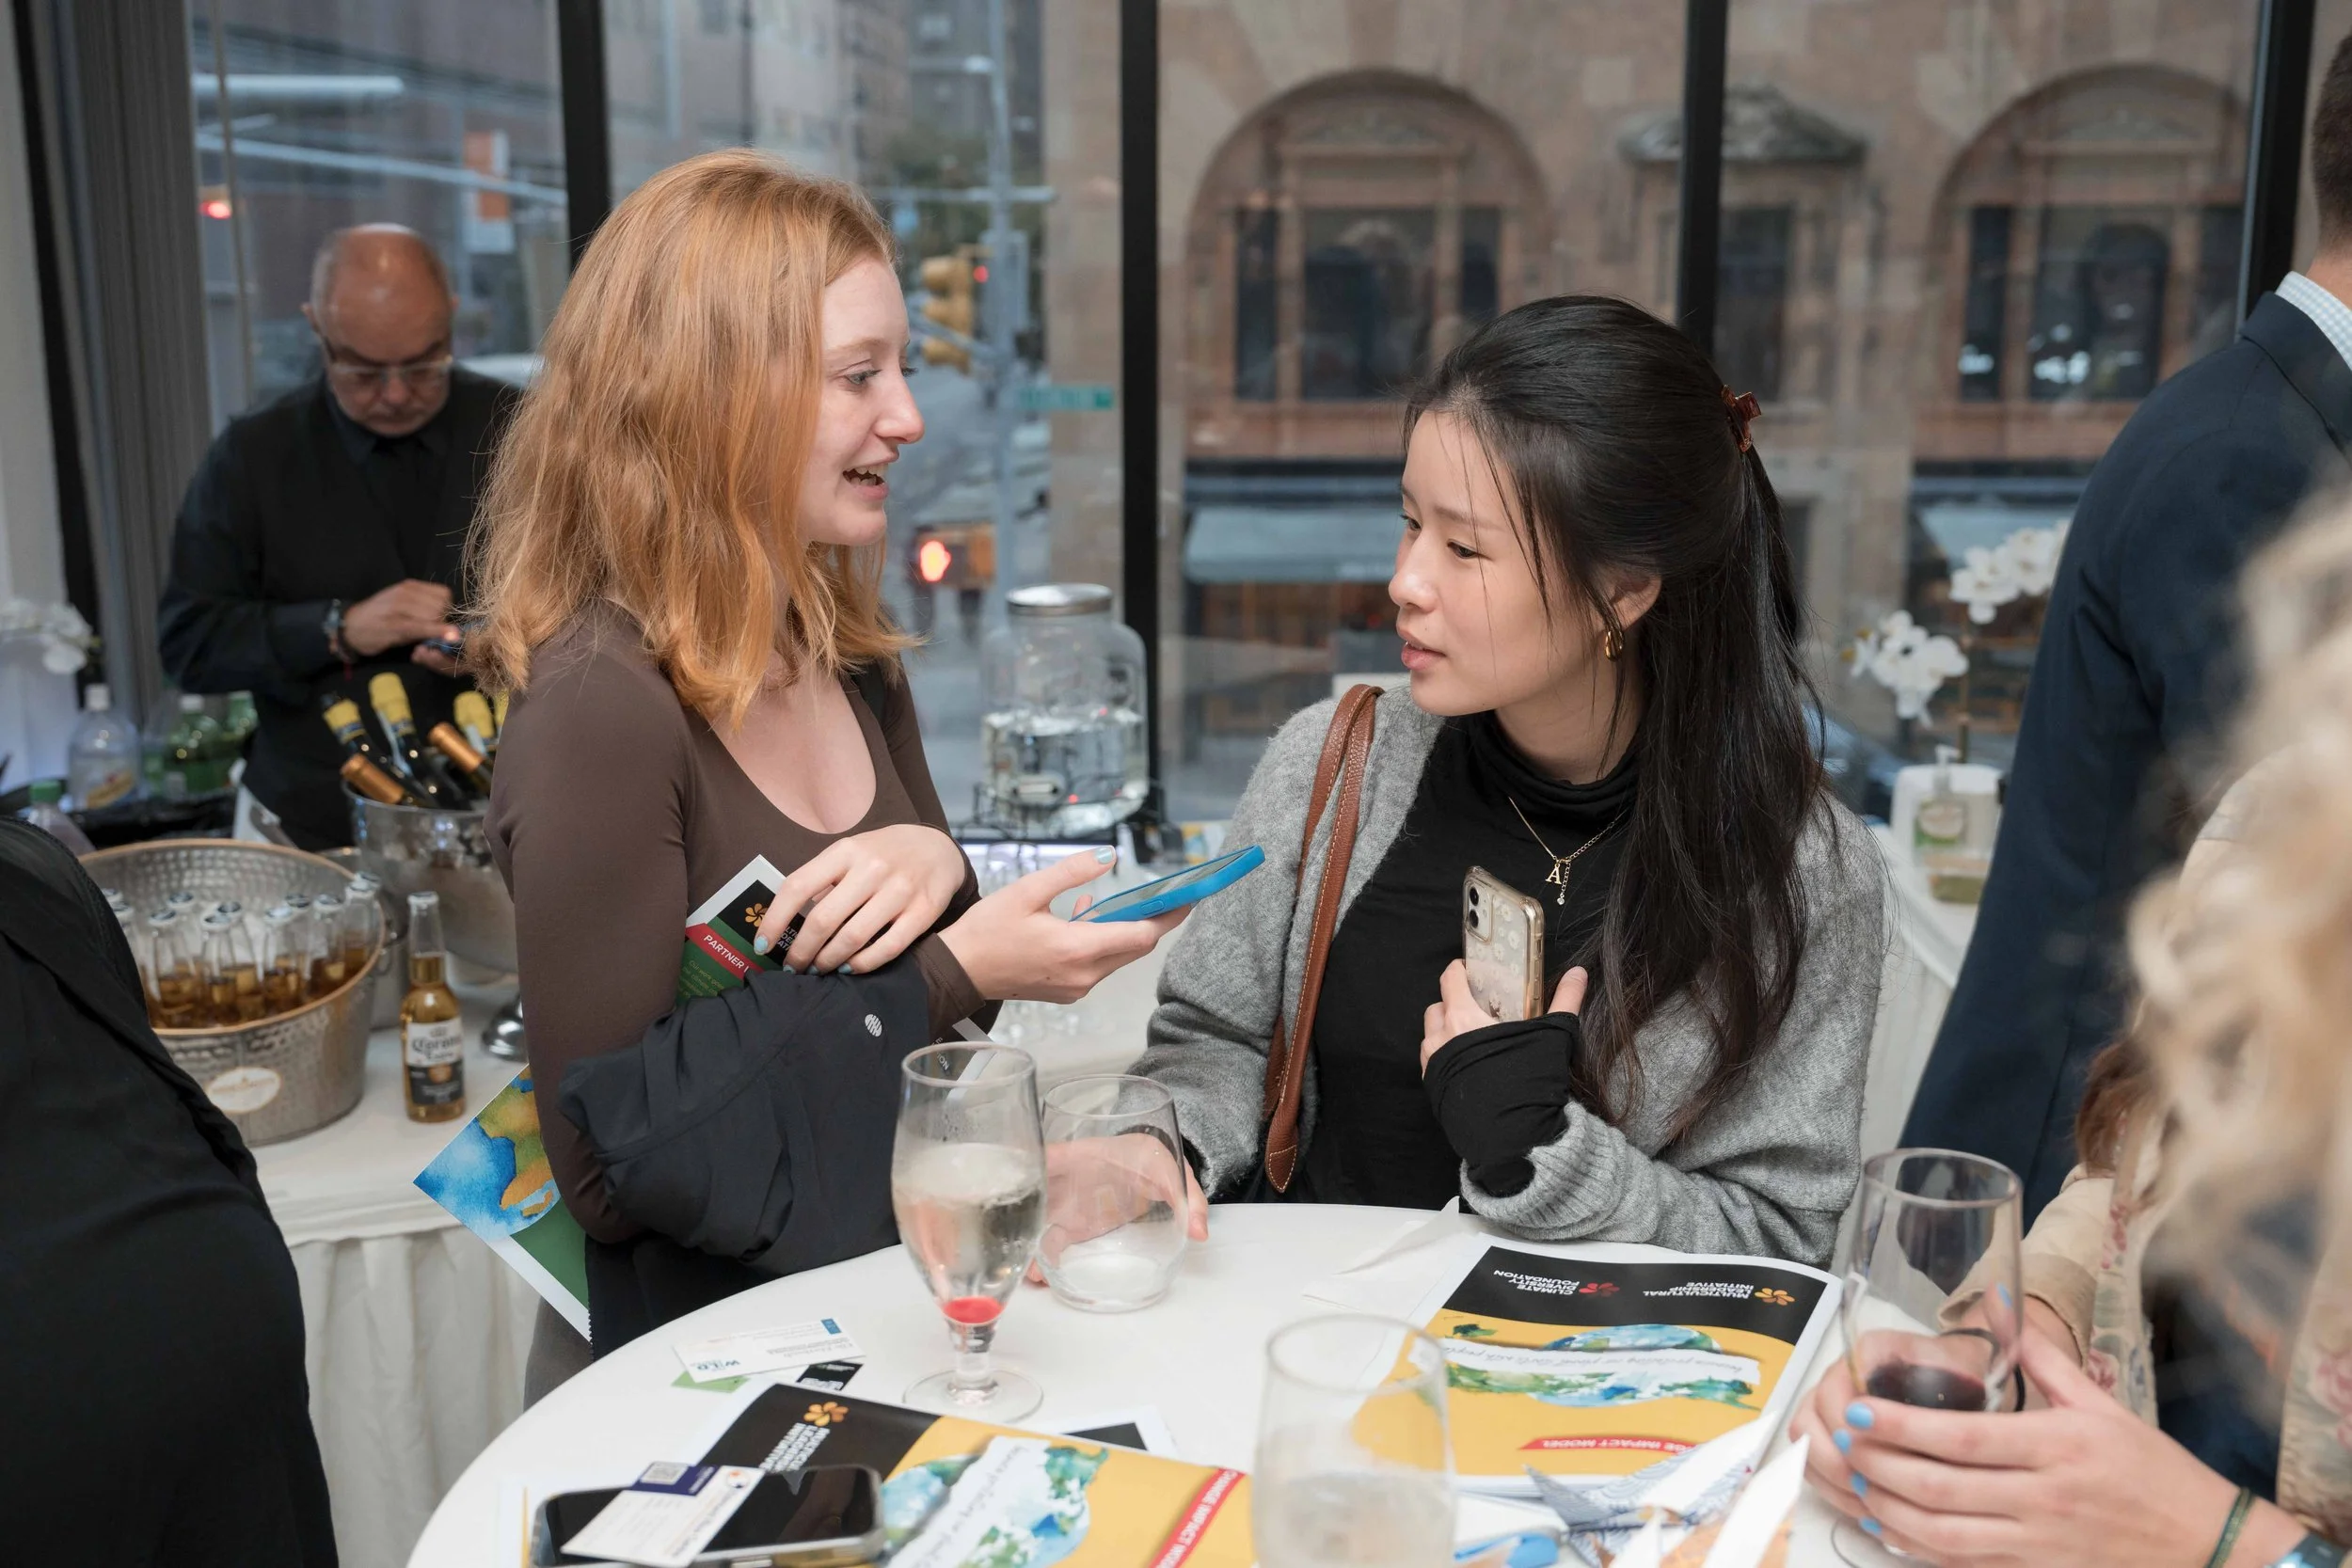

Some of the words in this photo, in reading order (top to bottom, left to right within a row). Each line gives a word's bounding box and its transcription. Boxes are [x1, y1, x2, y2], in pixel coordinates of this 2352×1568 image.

[1545, 864, 1562, 885] A
[703, 934, 745, 969] PARTNER
[1493, 1269, 1581, 1287] FOUNDATION
[1508, 1277, 1577, 1291] DIVERSITY
[1517, 1283, 1574, 1295] CLIMATE
[1686, 1282, 1755, 1291] INITIATIVE
[1643, 1291, 1750, 1299] MULTICULTURAL
[1669, 1286, 1753, 1294] LEADERSHIP
[1543, 1438, 1597, 1449] MODEL
[1598, 1439, 1661, 1449] IMPACT
